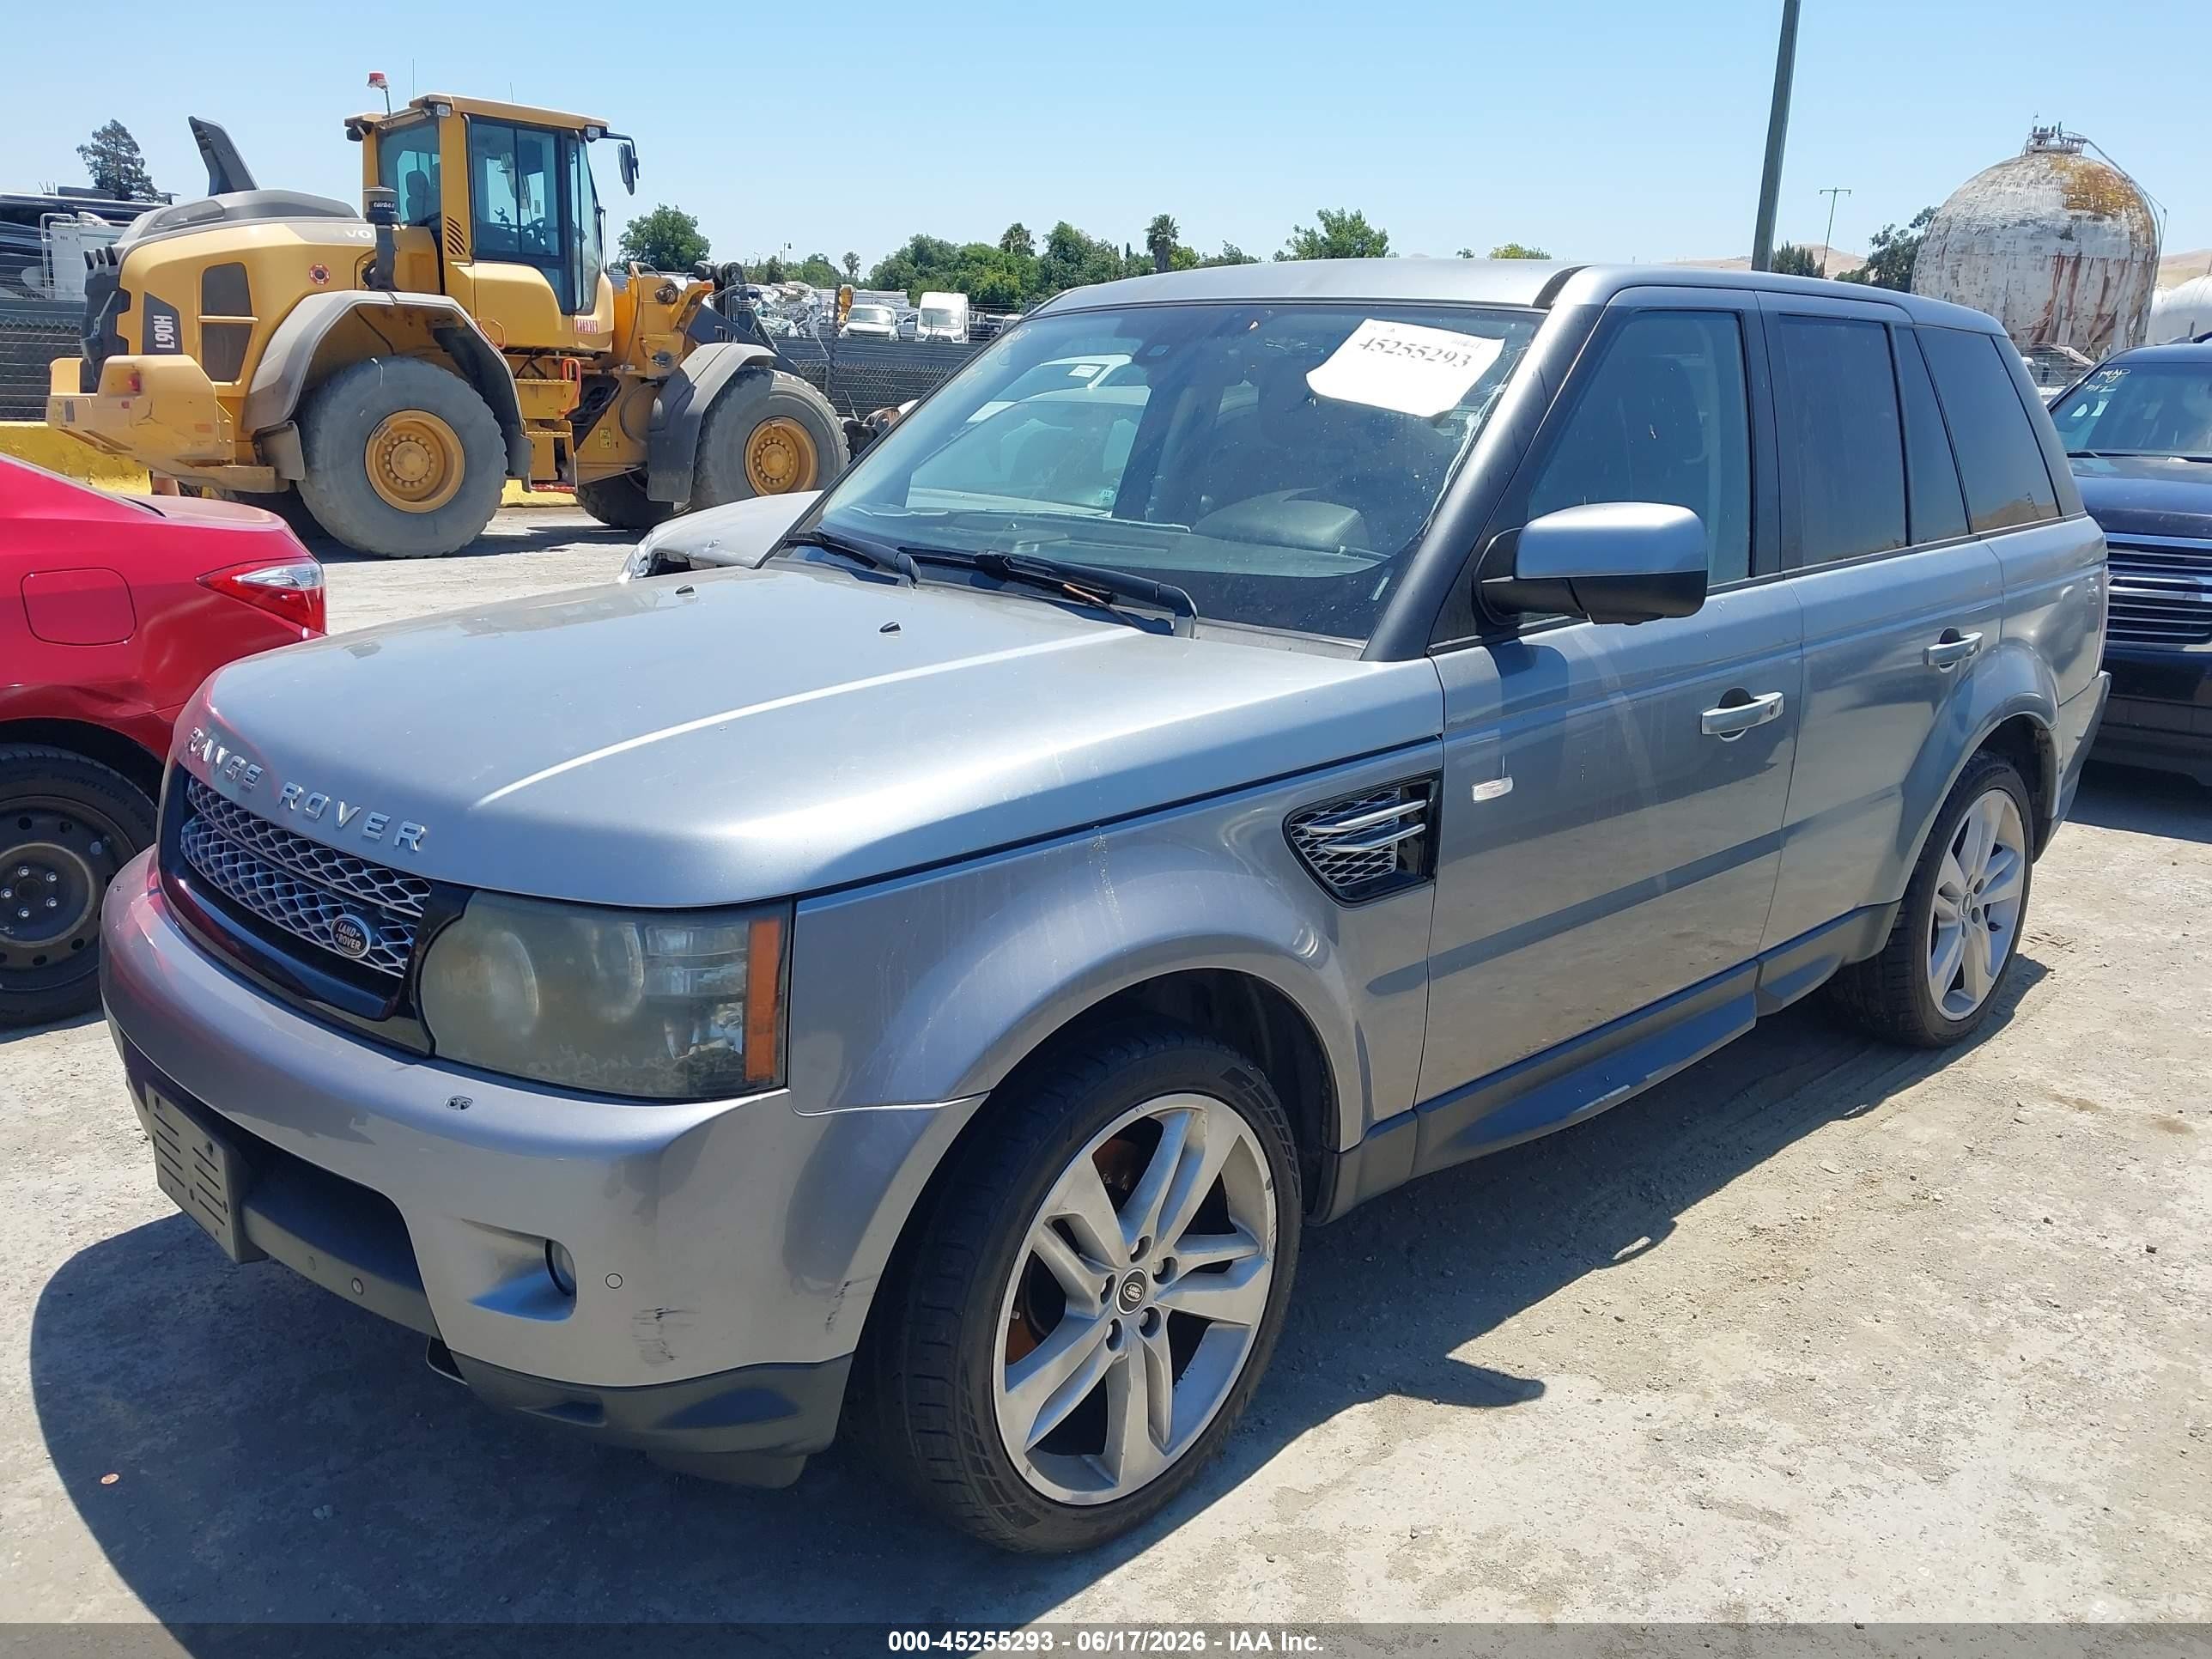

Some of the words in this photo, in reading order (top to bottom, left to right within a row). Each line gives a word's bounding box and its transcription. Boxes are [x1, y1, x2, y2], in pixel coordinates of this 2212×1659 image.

[153, 315, 175, 349] L90H
[1358, 337, 1473, 368] 45255293
[185, 727, 264, 789] RANGE
[278, 782, 427, 852] ROVER
[337, 922, 356, 937] LAND
[337, 933, 361, 951] ROVER
